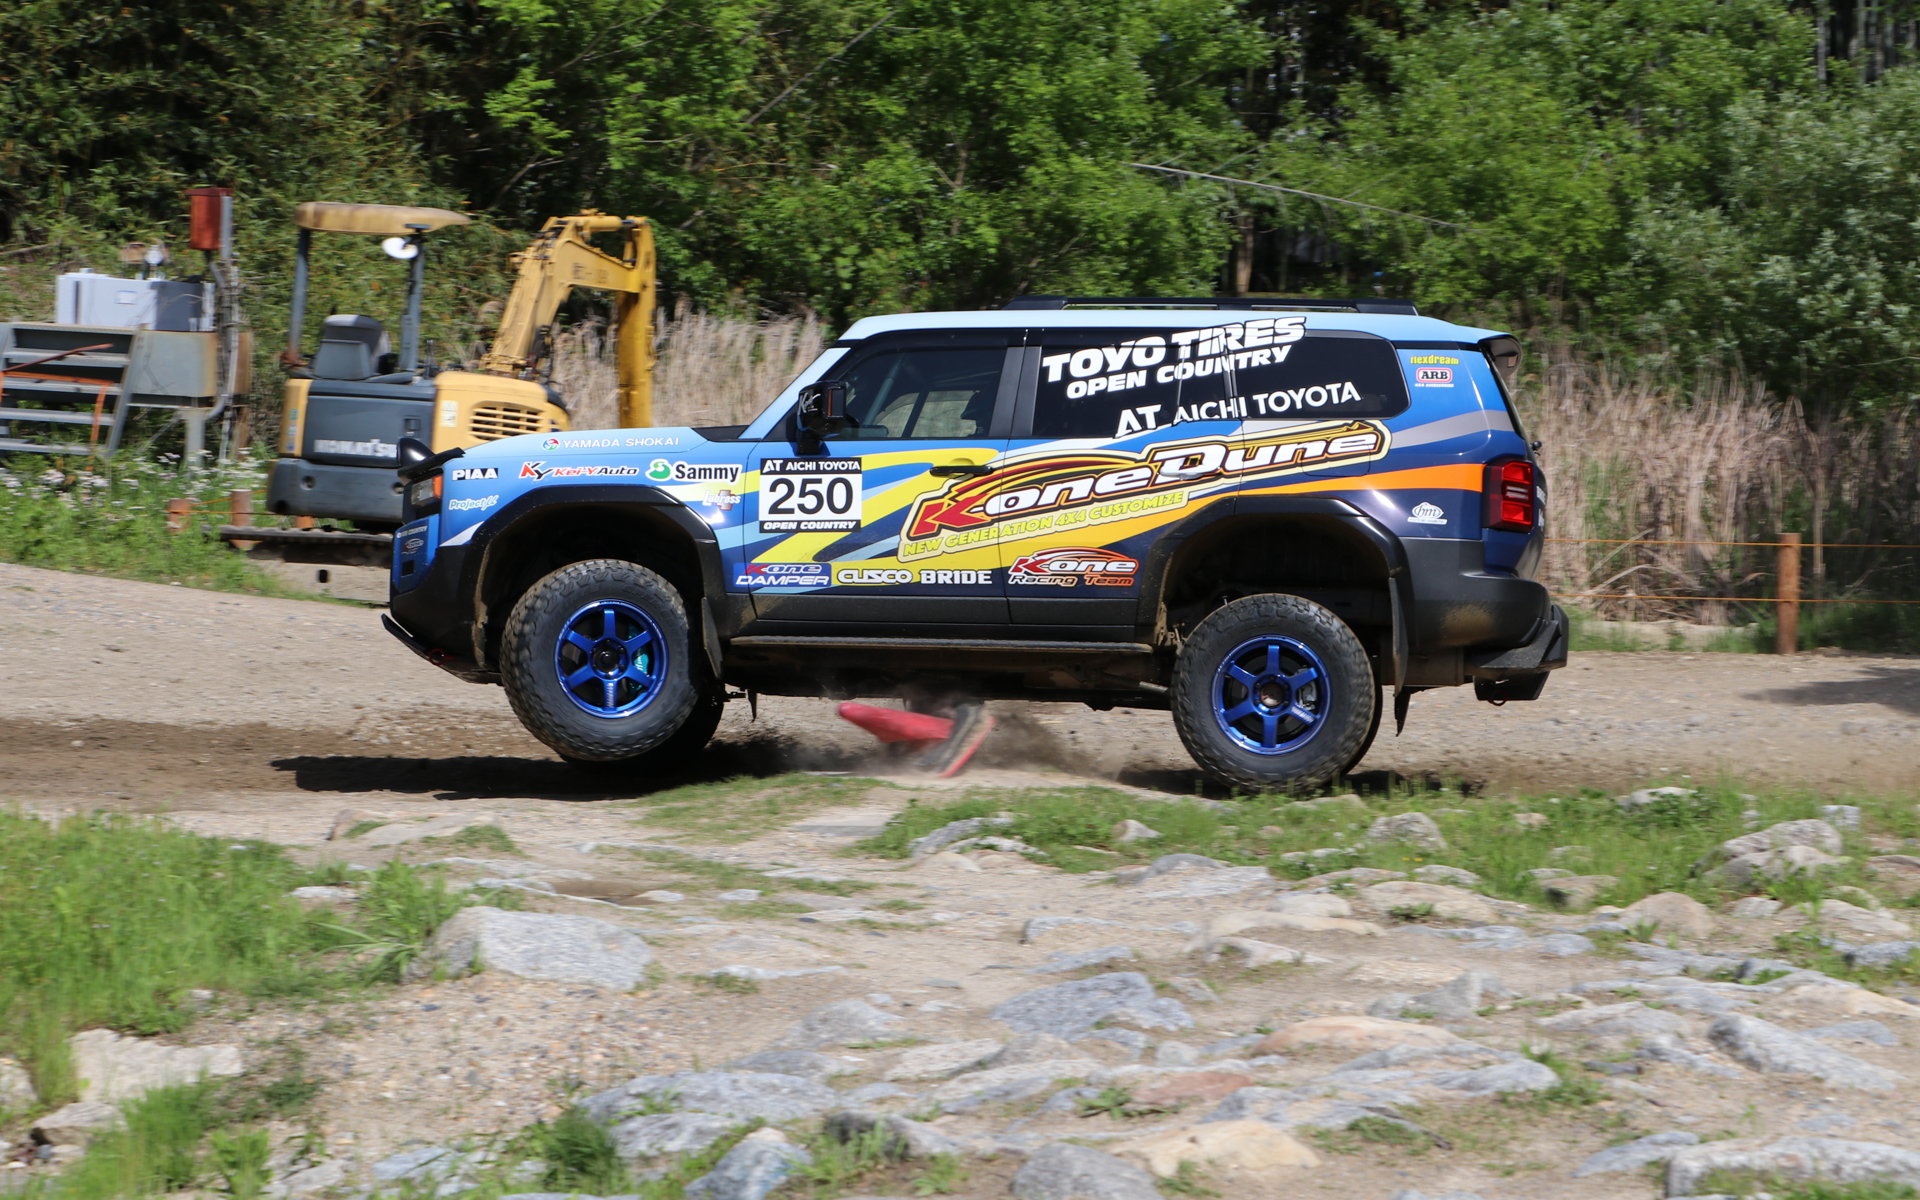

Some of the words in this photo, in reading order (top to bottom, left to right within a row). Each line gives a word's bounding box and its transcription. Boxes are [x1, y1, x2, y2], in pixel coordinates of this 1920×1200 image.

[1042, 336, 1167, 382] TOYO
[1171, 316, 1306, 360] TIRES
[1066, 370, 1147, 399] OPEN
[1156, 345, 1292, 384] COUNTRY
[1421, 371, 1448, 379] ARB
[1114, 404, 1162, 438] AT
[1173, 396, 1248, 426] AICHI
[1252, 381, 1362, 415] TOYOTA
[563, 438, 620, 449] YAMADA
[625, 437, 679, 447] SHOKAI
[675, 463, 740, 482] Sammy
[763, 460, 784, 473] AT
[786, 461, 816, 471] AICHI
[818, 461, 860, 471] TOYOTA
[452, 468, 498, 481] PIAA
[768, 477, 853, 515] 250
[763, 522, 798, 530] OPEN
[800, 521, 857, 530] COUNTRY
[903, 538, 944, 557] NEW
[945, 516, 1052, 547] GENERATION
[1055, 509, 1087, 526] 4X4
[1089, 491, 1184, 520] CUSTOMIZE
[735, 575, 829, 585] DAMPER
[837, 569, 913, 584] CUSCO
[919, 569, 992, 585] BRIDE
[1008, 574, 1078, 587] Racing
[1084, 574, 1134, 586] Team
